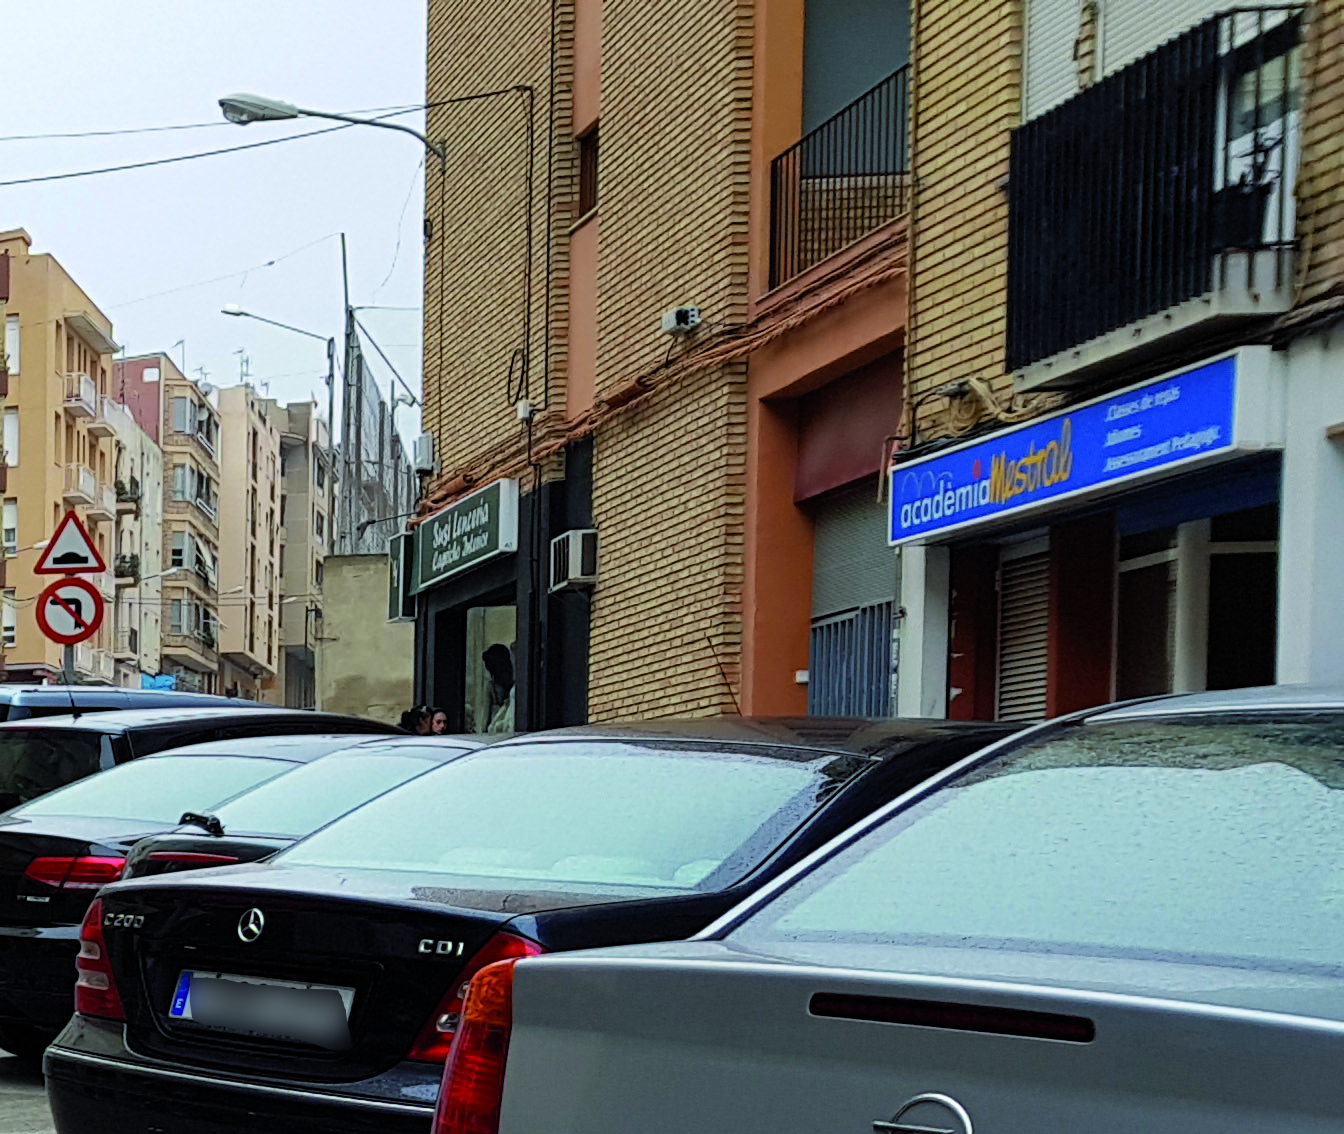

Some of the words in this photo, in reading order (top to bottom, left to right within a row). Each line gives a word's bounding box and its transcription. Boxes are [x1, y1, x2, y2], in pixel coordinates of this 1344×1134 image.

[900, 464, 992, 529] acadèmia
[989, 417, 1074, 506] Mestral
[103, 912, 145, 929] C200
[417, 938, 465, 957] CDI
